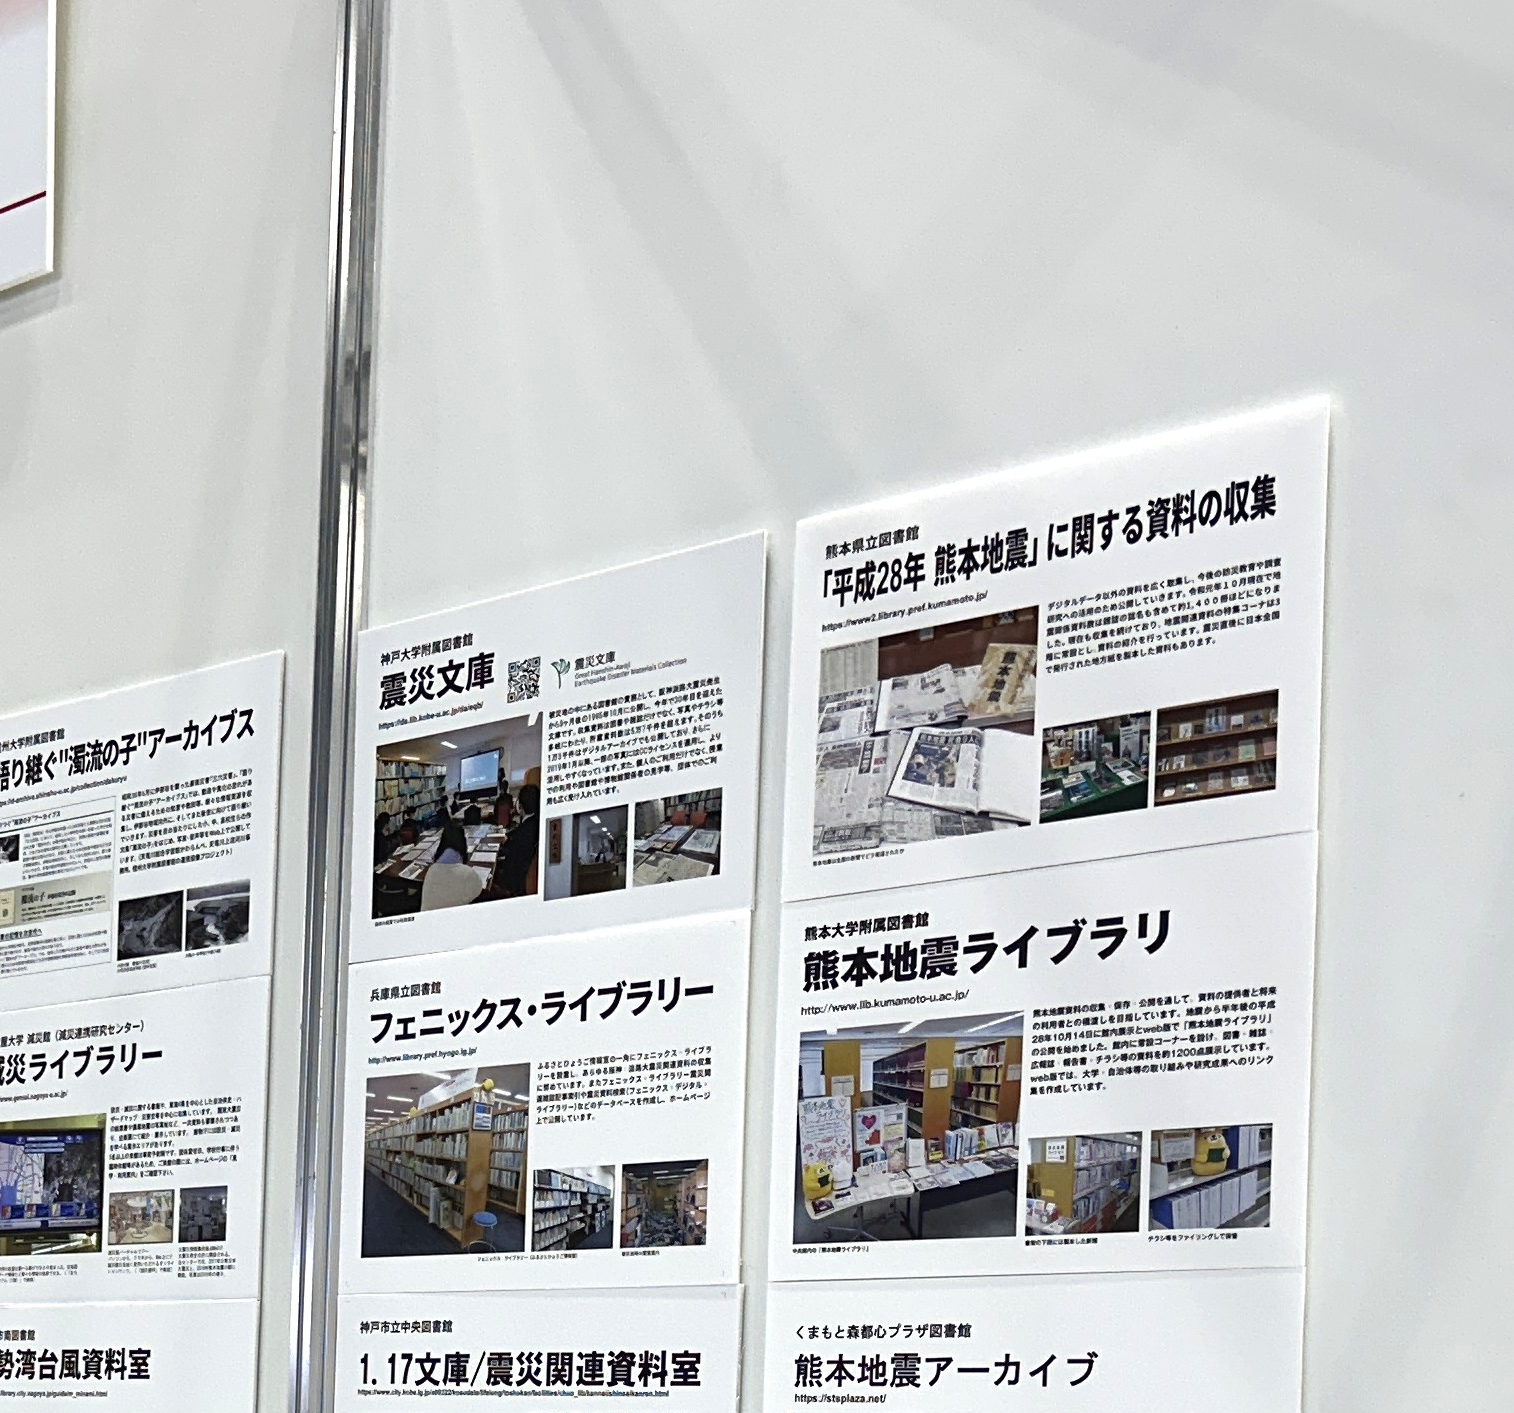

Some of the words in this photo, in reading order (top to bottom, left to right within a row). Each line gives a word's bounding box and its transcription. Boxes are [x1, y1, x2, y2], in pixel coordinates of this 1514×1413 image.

[826, 526, 919, 559] 熊本県立図書館
[823, 552, 925, 607] 「平成28年
[380, 632, 473, 666] 神戸大学附属図書館
[575, 651, 615, 670] 震災文庫
[378, 652, 495, 711] 震災文庫
[804, 912, 929, 942] 熊本大学附属図書館
[803, 910, 1170, 992] 熊本地震ライブラリ
[370, 980, 441, 1002] 兵庫県立図書館
[801, 989, 969, 1016] http://www.lib.kumamoto-u.ac.jp/
[371, 977, 713, 1043] フェニックス・ライブラリー
[360, 1319, 452, 1333] 神戸市立中央図書館
[795, 1323, 971, 1340] くまもと森都心プラザ図書館
[793, 1351, 1098, 1388] 熊本地震アーカイブ
